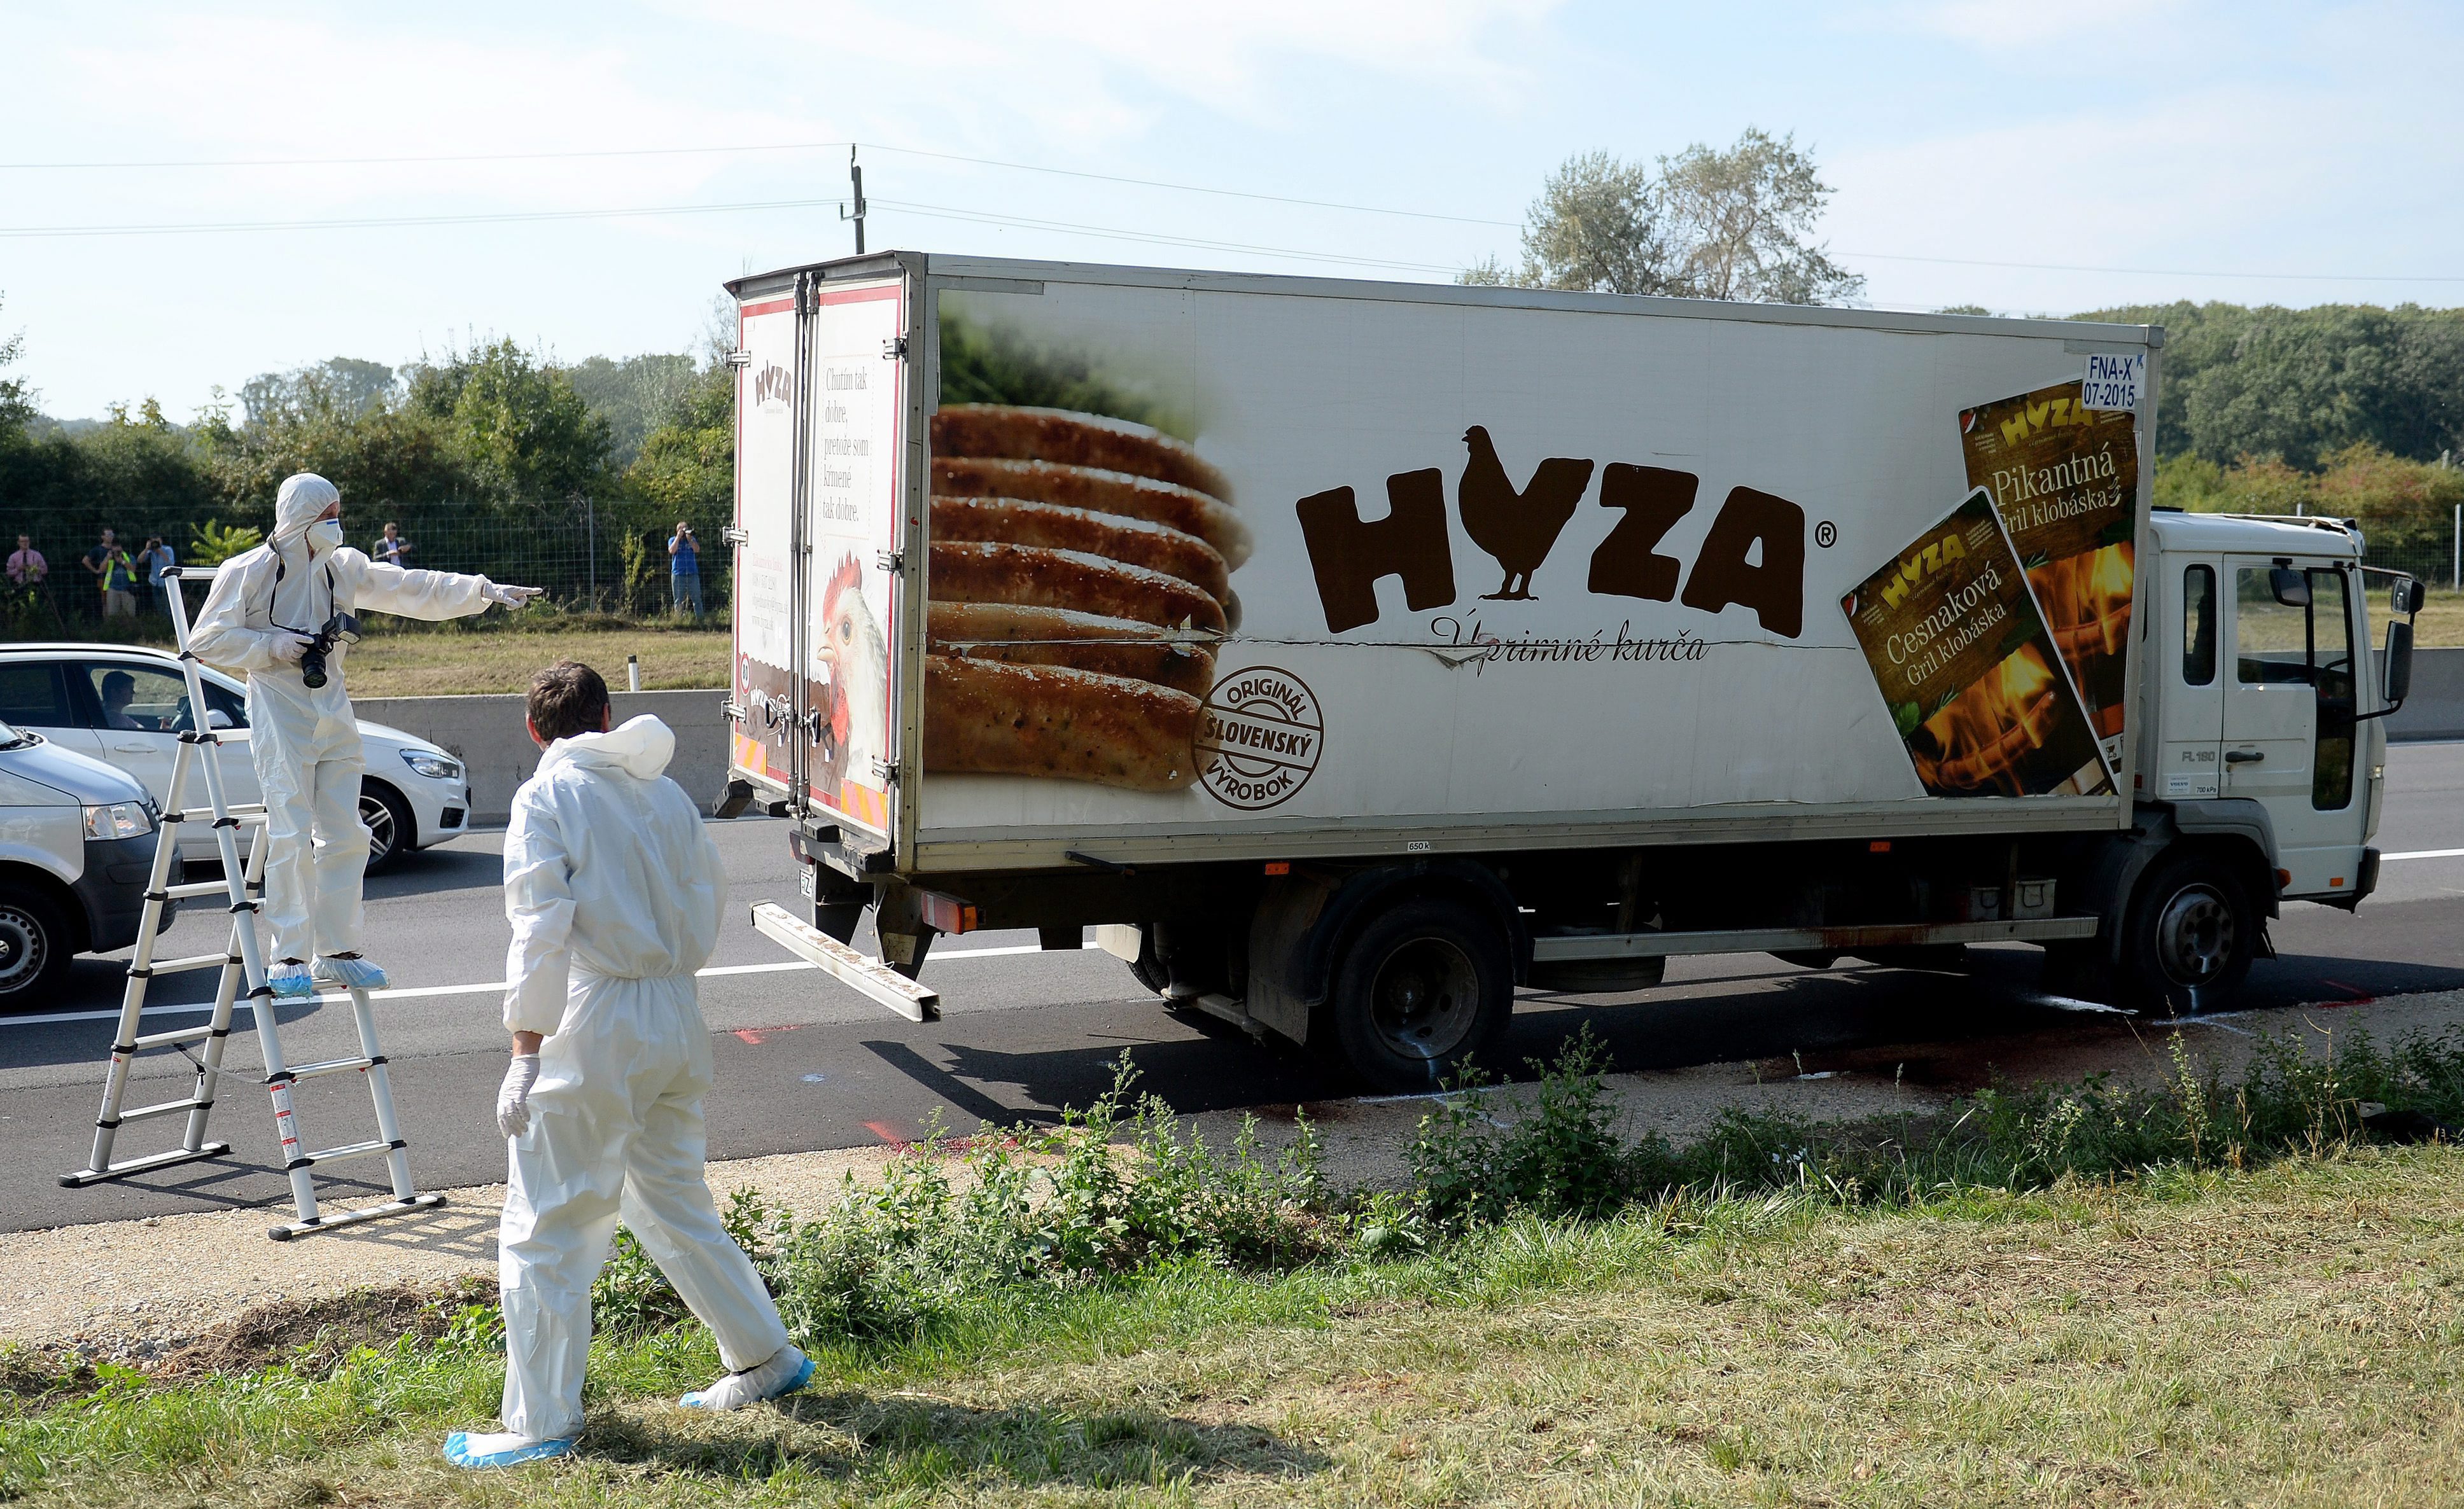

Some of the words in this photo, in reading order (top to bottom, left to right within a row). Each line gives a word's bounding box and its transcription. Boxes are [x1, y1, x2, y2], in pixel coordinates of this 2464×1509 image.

[755, 359, 791, 408] HYZA
[826, 367, 853, 391] Chutím
[855, 366, 867, 390] tak
[2090, 356, 2133, 380] FNA-X
[825, 400, 848, 429] dobre,
[2084, 382, 2135, 407] 07-2015
[824, 434, 851, 460] pretože
[853, 438, 869, 456] som
[823, 464, 851, 488] kŕmené
[1992, 442, 2115, 507] Pikantná
[823, 496, 834, 519] tak
[836, 497, 858, 522] dobre.
[2033, 489, 2108, 527] klobáska
[1295, 424, 1806, 639] HYZA
[1880, 534, 1966, 611] HYZA
[1887, 560, 2001, 665] Cesnaková
[1611, 618, 1711, 662] kurča
[1907, 651, 1939, 685] Gril
[1936, 604, 2006, 664] klobáska
[1227, 678, 1308, 721] ORIGINÁL
[1204, 716, 1313, 758] SLOVENSKÝ
[1206, 758, 1294, 801] VÝROBOK
